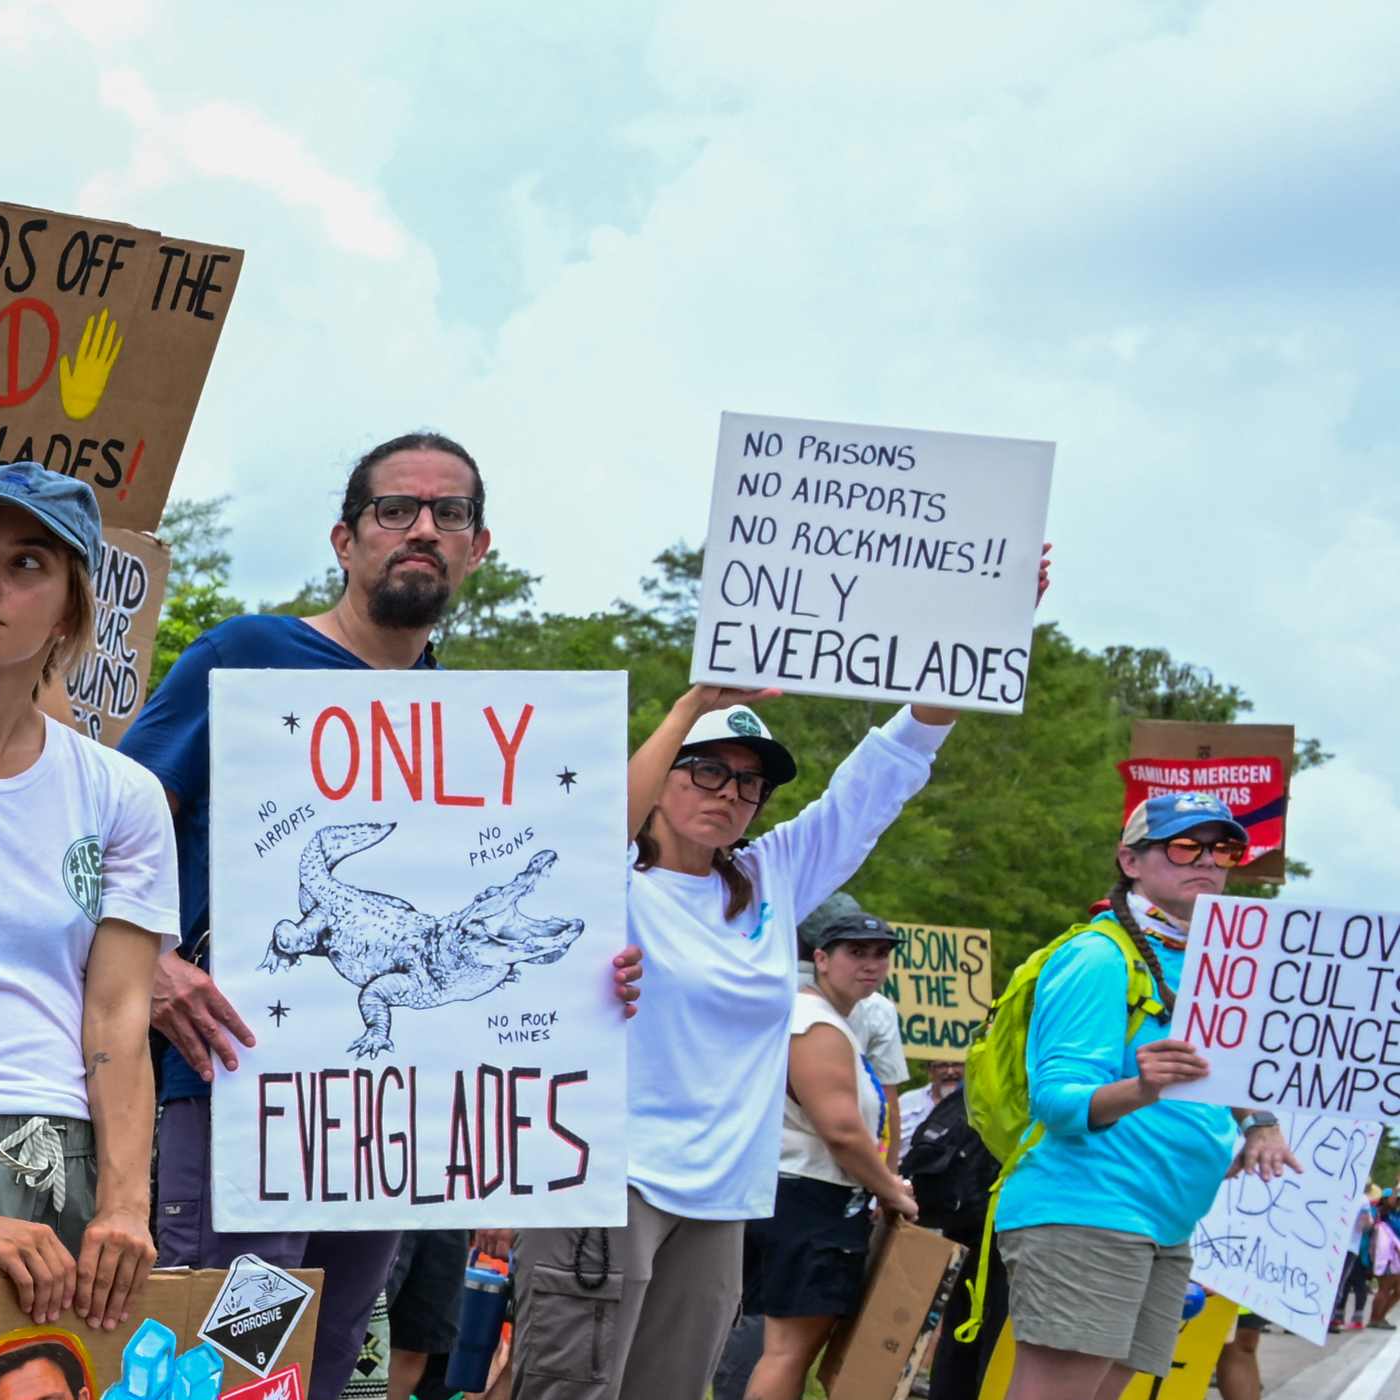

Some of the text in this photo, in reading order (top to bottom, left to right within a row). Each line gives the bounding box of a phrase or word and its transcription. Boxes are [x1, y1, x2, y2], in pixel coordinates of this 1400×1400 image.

[57, 230, 136, 298] OFF
[152, 245, 231, 321] THE
[743, 430, 917, 472] NO PRISONS
[737, 471, 947, 524] NO AIRPORTS
[729, 514, 777, 545] NO
[720, 559, 859, 623] ONLY
[707, 620, 1029, 705] EVERGLADES
[309, 699, 535, 807] ONLY
[1129, 764, 1273, 787] FAMILIAS MERECEN
[254, 804, 316, 859] AIRPORTS
[258, 800, 278, 822] NO
[469, 827, 535, 867] PRISONS
[479, 826, 501, 846] NO
[1203, 901, 1268, 951] NO
[909, 973, 959, 1008] THE
[1194, 952, 1258, 1000] NO
[487, 1010, 560, 1029] NO ROCK
[498, 1029, 551, 1045] MINES
[1183, 1002, 1248, 1049] NO
[1248, 1059, 1400, 1117] CAMPS
[257, 1062, 591, 1206] EVERGLADES
[230, 1305, 284, 1338] CORROSIVE
[255, 1350, 267, 1366] 8
